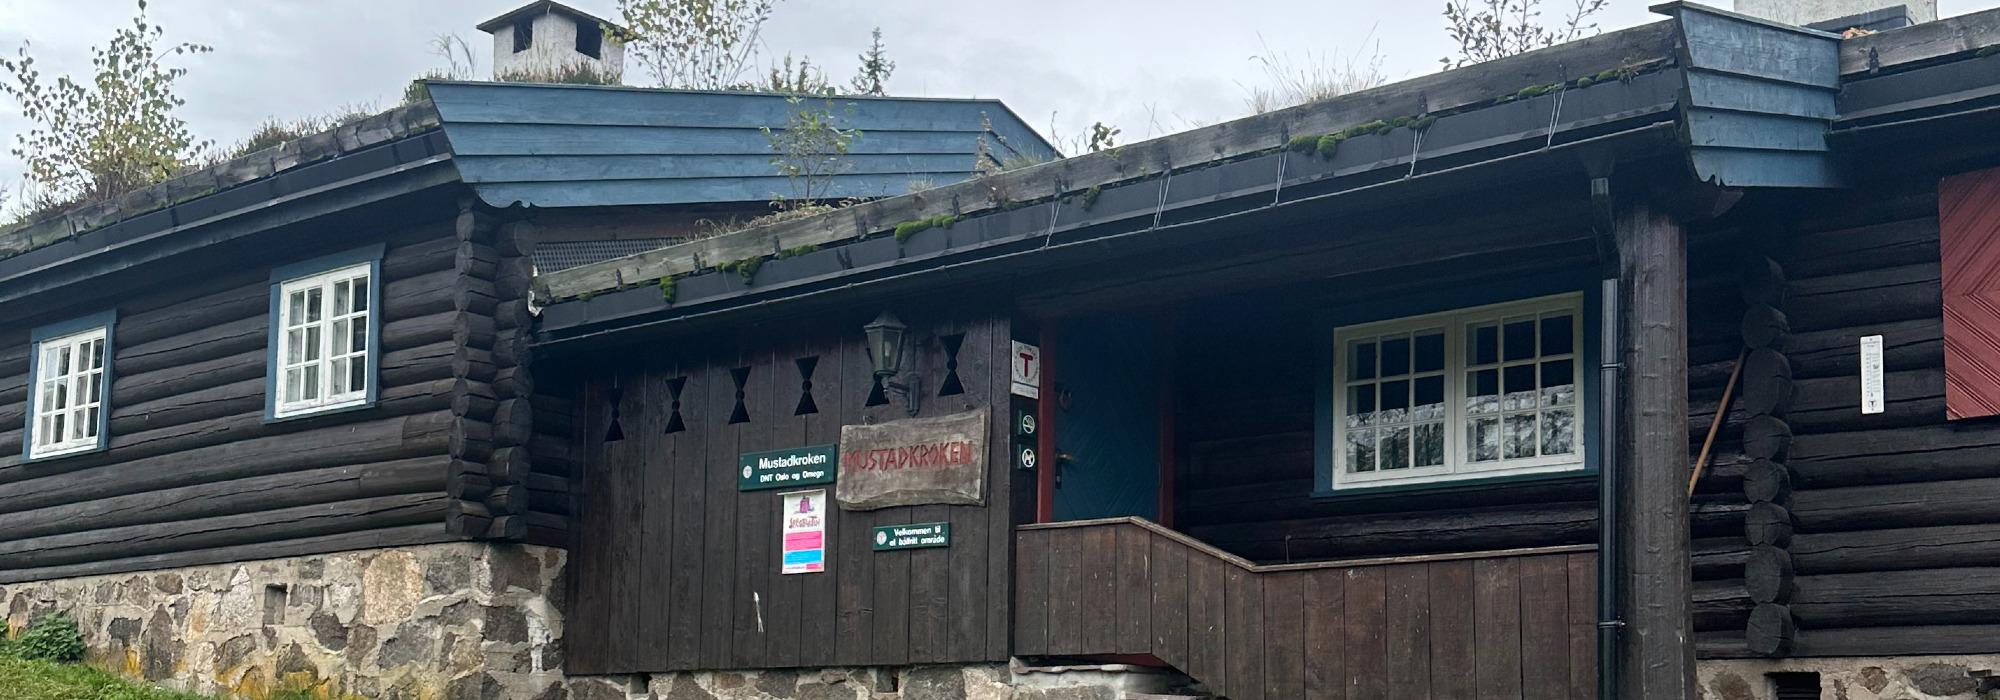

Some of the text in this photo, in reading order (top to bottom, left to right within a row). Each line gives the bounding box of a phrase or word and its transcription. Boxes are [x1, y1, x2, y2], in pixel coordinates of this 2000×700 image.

[1019, 352, 1034, 378] T
[759, 452, 826, 470] Mustadkroken
[843, 441, 974, 475] MUSTADKROKEN
[760, 470, 825, 483] DNT Oslo og Omegn
[893, 527, 932, 537] Velkommen
[920, 535, 945, 544] område
